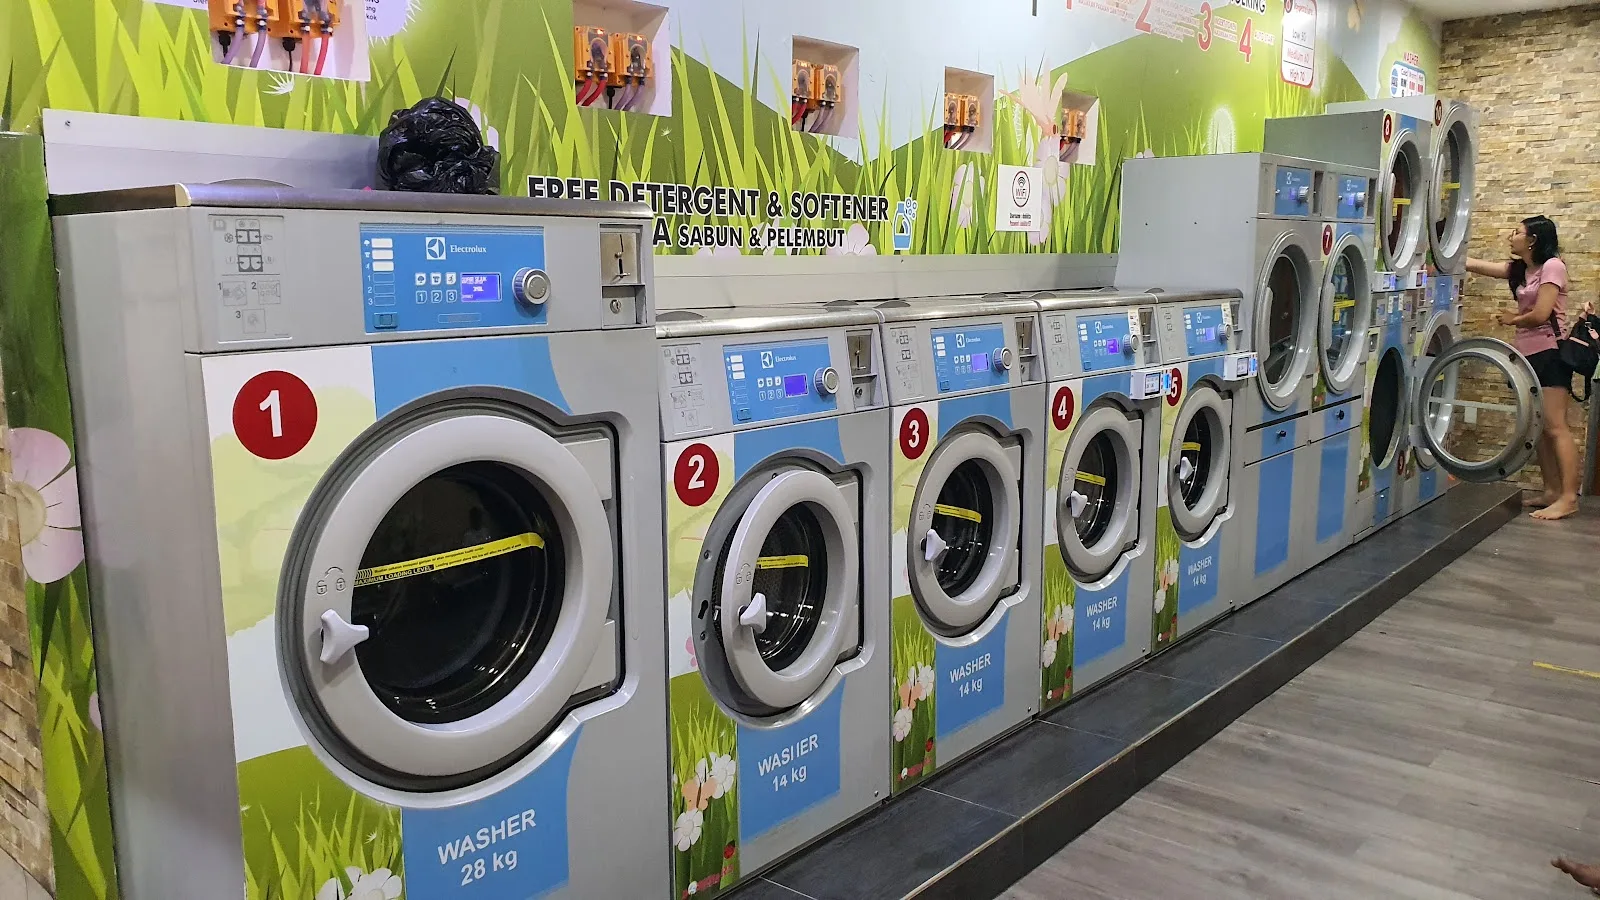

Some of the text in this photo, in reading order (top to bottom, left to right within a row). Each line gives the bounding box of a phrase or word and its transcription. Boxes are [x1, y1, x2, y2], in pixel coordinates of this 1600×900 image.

[1199, 2, 1212, 50] 3
[1240, 18, 1252, 62] 4
[1290, 69, 1300, 81] High
[1385, 119, 1390, 136] 8
[528, 176, 889, 221] FREE DETERGENT & SOFTENER
[678, 225, 743, 247] SABUN
[749, 228, 761, 248] &
[767, 229, 845, 248] PELEMBUT
[1325, 231, 1331, 249] 7
[450, 245, 487, 254] Electrolux
[251, 282, 257, 290] 2
[433, 292, 440, 301] 2
[448, 291, 455, 301] 3
[235, 311, 241, 319] 3
[1170, 376, 1178, 398] 5
[258, 388, 283, 438] 1
[1057, 395, 1068, 420] 4
[908, 419, 920, 449] 3
[687, 454, 706, 490] 2
[384, 569, 413, 580] LOADING
[412, 565, 434, 575] LEVEL
[1187, 555, 1212, 576] WASHER
[1086, 596, 1118, 618] WASHER
[1092, 616, 1111, 632] 14 kg
[949, 652, 991, 684] WASHER
[959, 677, 983, 698] 14 kg
[772, 765, 807, 792] 14 kg
[437, 808, 537, 865] WASHER
[461, 850, 518, 887] 28 kg
